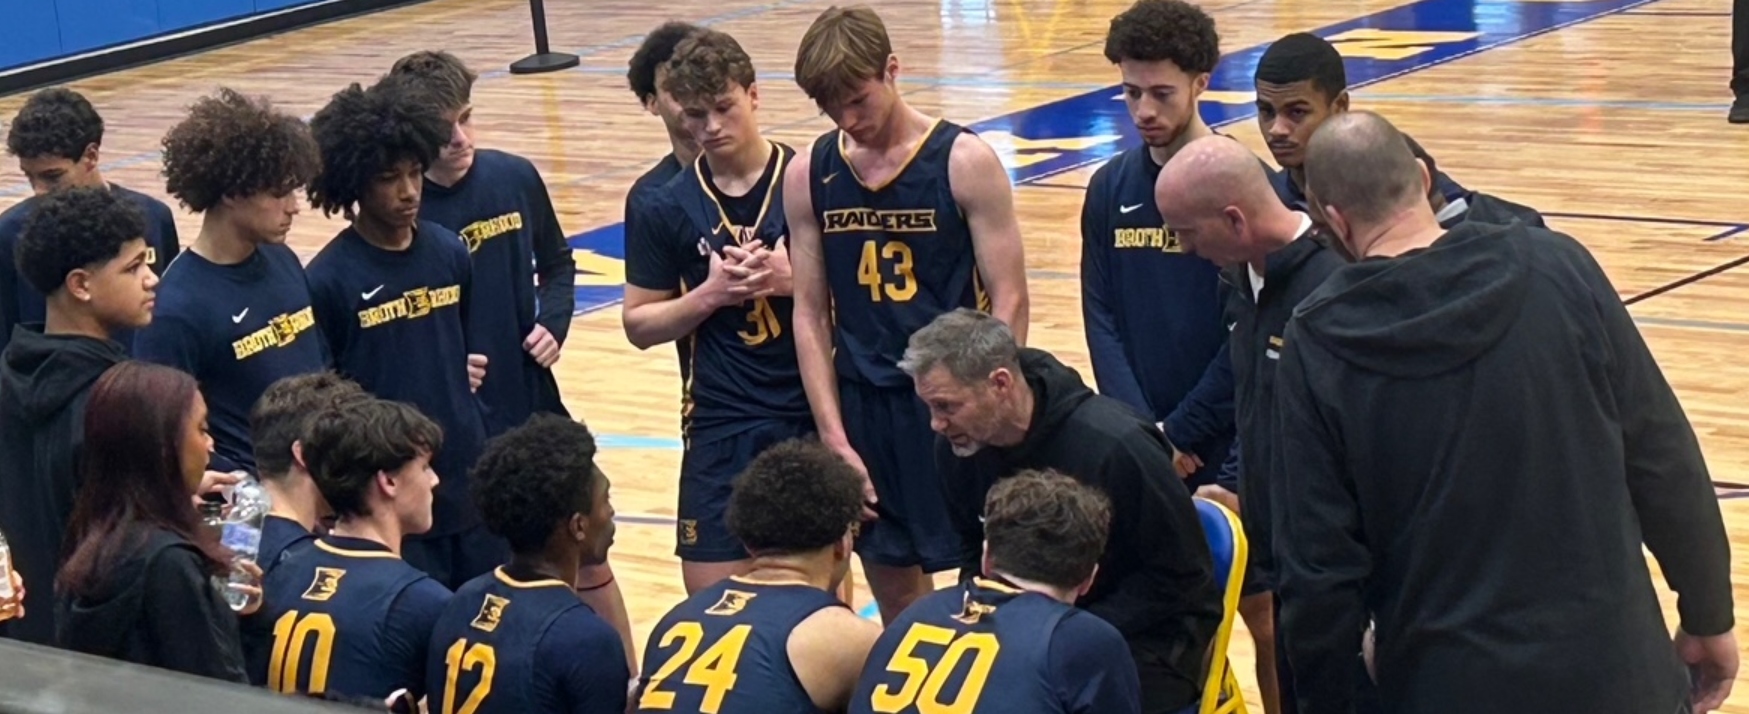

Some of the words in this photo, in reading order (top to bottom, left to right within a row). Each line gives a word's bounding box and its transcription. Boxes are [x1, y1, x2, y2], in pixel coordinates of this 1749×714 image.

[824, 209, 937, 232] RAIDERS
[857, 240, 919, 302] 43
[267, 609, 336, 695] 10
[441, 637, 497, 714] 12
[638, 621, 753, 714] 24
[870, 622, 1000, 714] 50
